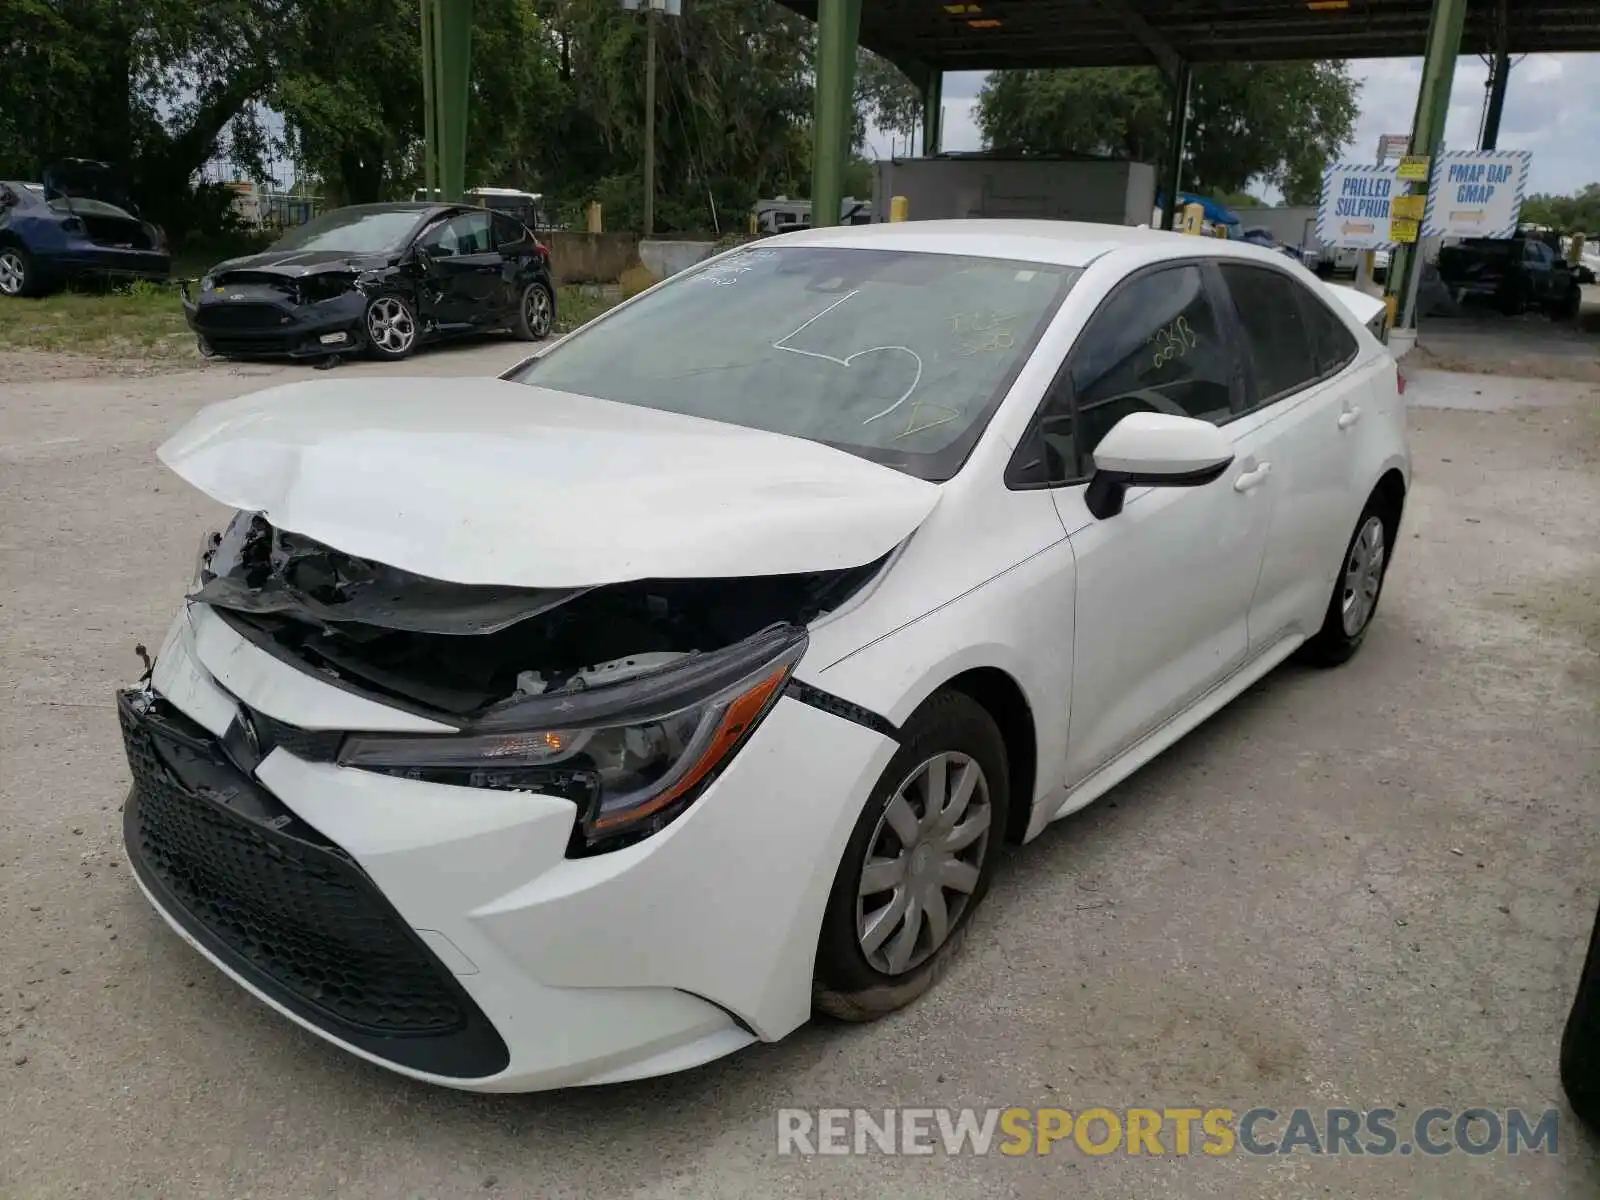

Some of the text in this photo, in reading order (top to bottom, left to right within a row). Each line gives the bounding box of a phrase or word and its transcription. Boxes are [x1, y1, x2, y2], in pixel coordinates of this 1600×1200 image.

[1448, 163, 1486, 183] PMAP
[1486, 164, 1513, 184] DAP
[1341, 177, 1391, 197] PRILLED
[1457, 184, 1495, 204] GMAP
[1335, 197, 1390, 218] SULPHUR
